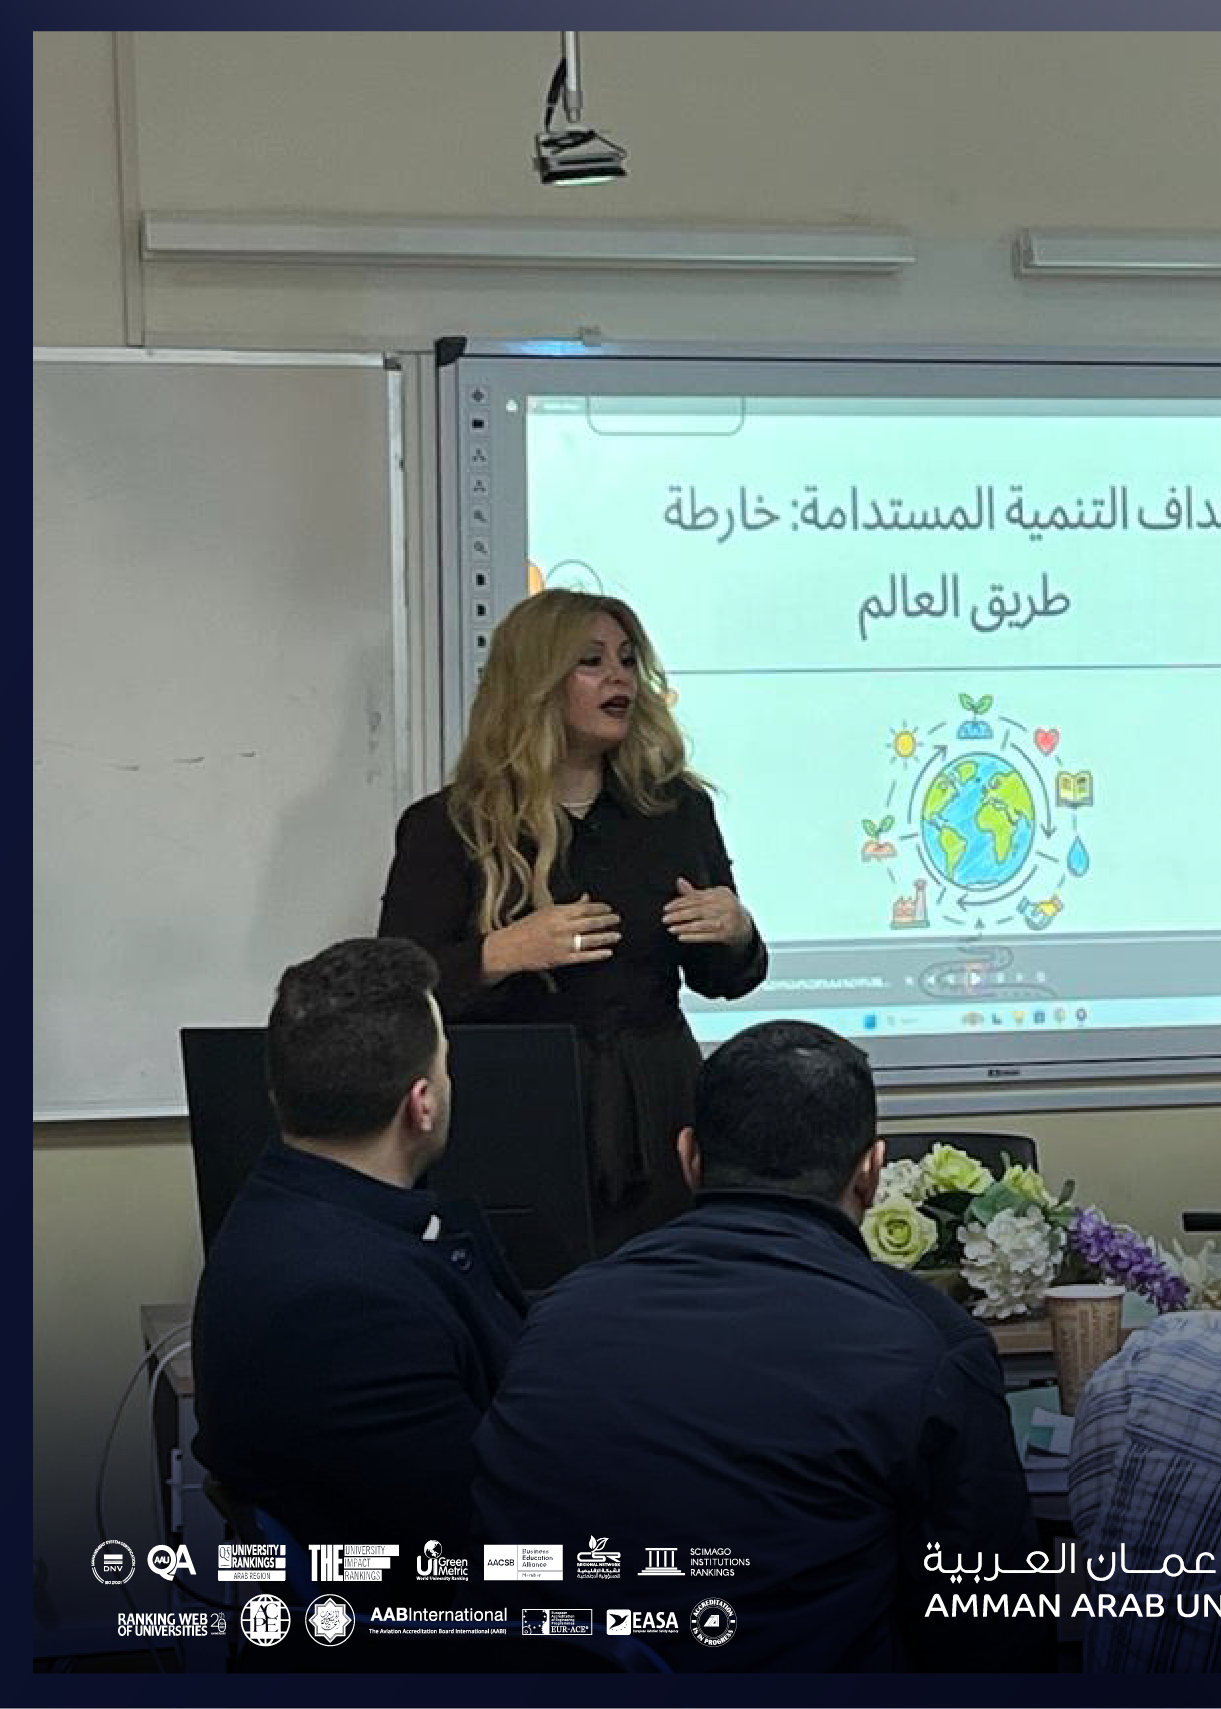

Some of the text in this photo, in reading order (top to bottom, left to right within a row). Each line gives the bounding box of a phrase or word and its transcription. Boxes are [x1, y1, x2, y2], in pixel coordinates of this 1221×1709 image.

[663, 486, 780, 543] خارطة
[792, 486, 996, 531] المستدامة:
[1004, 486, 1129, 541] التنمية
[859, 573, 1072, 641] طريق العالم
